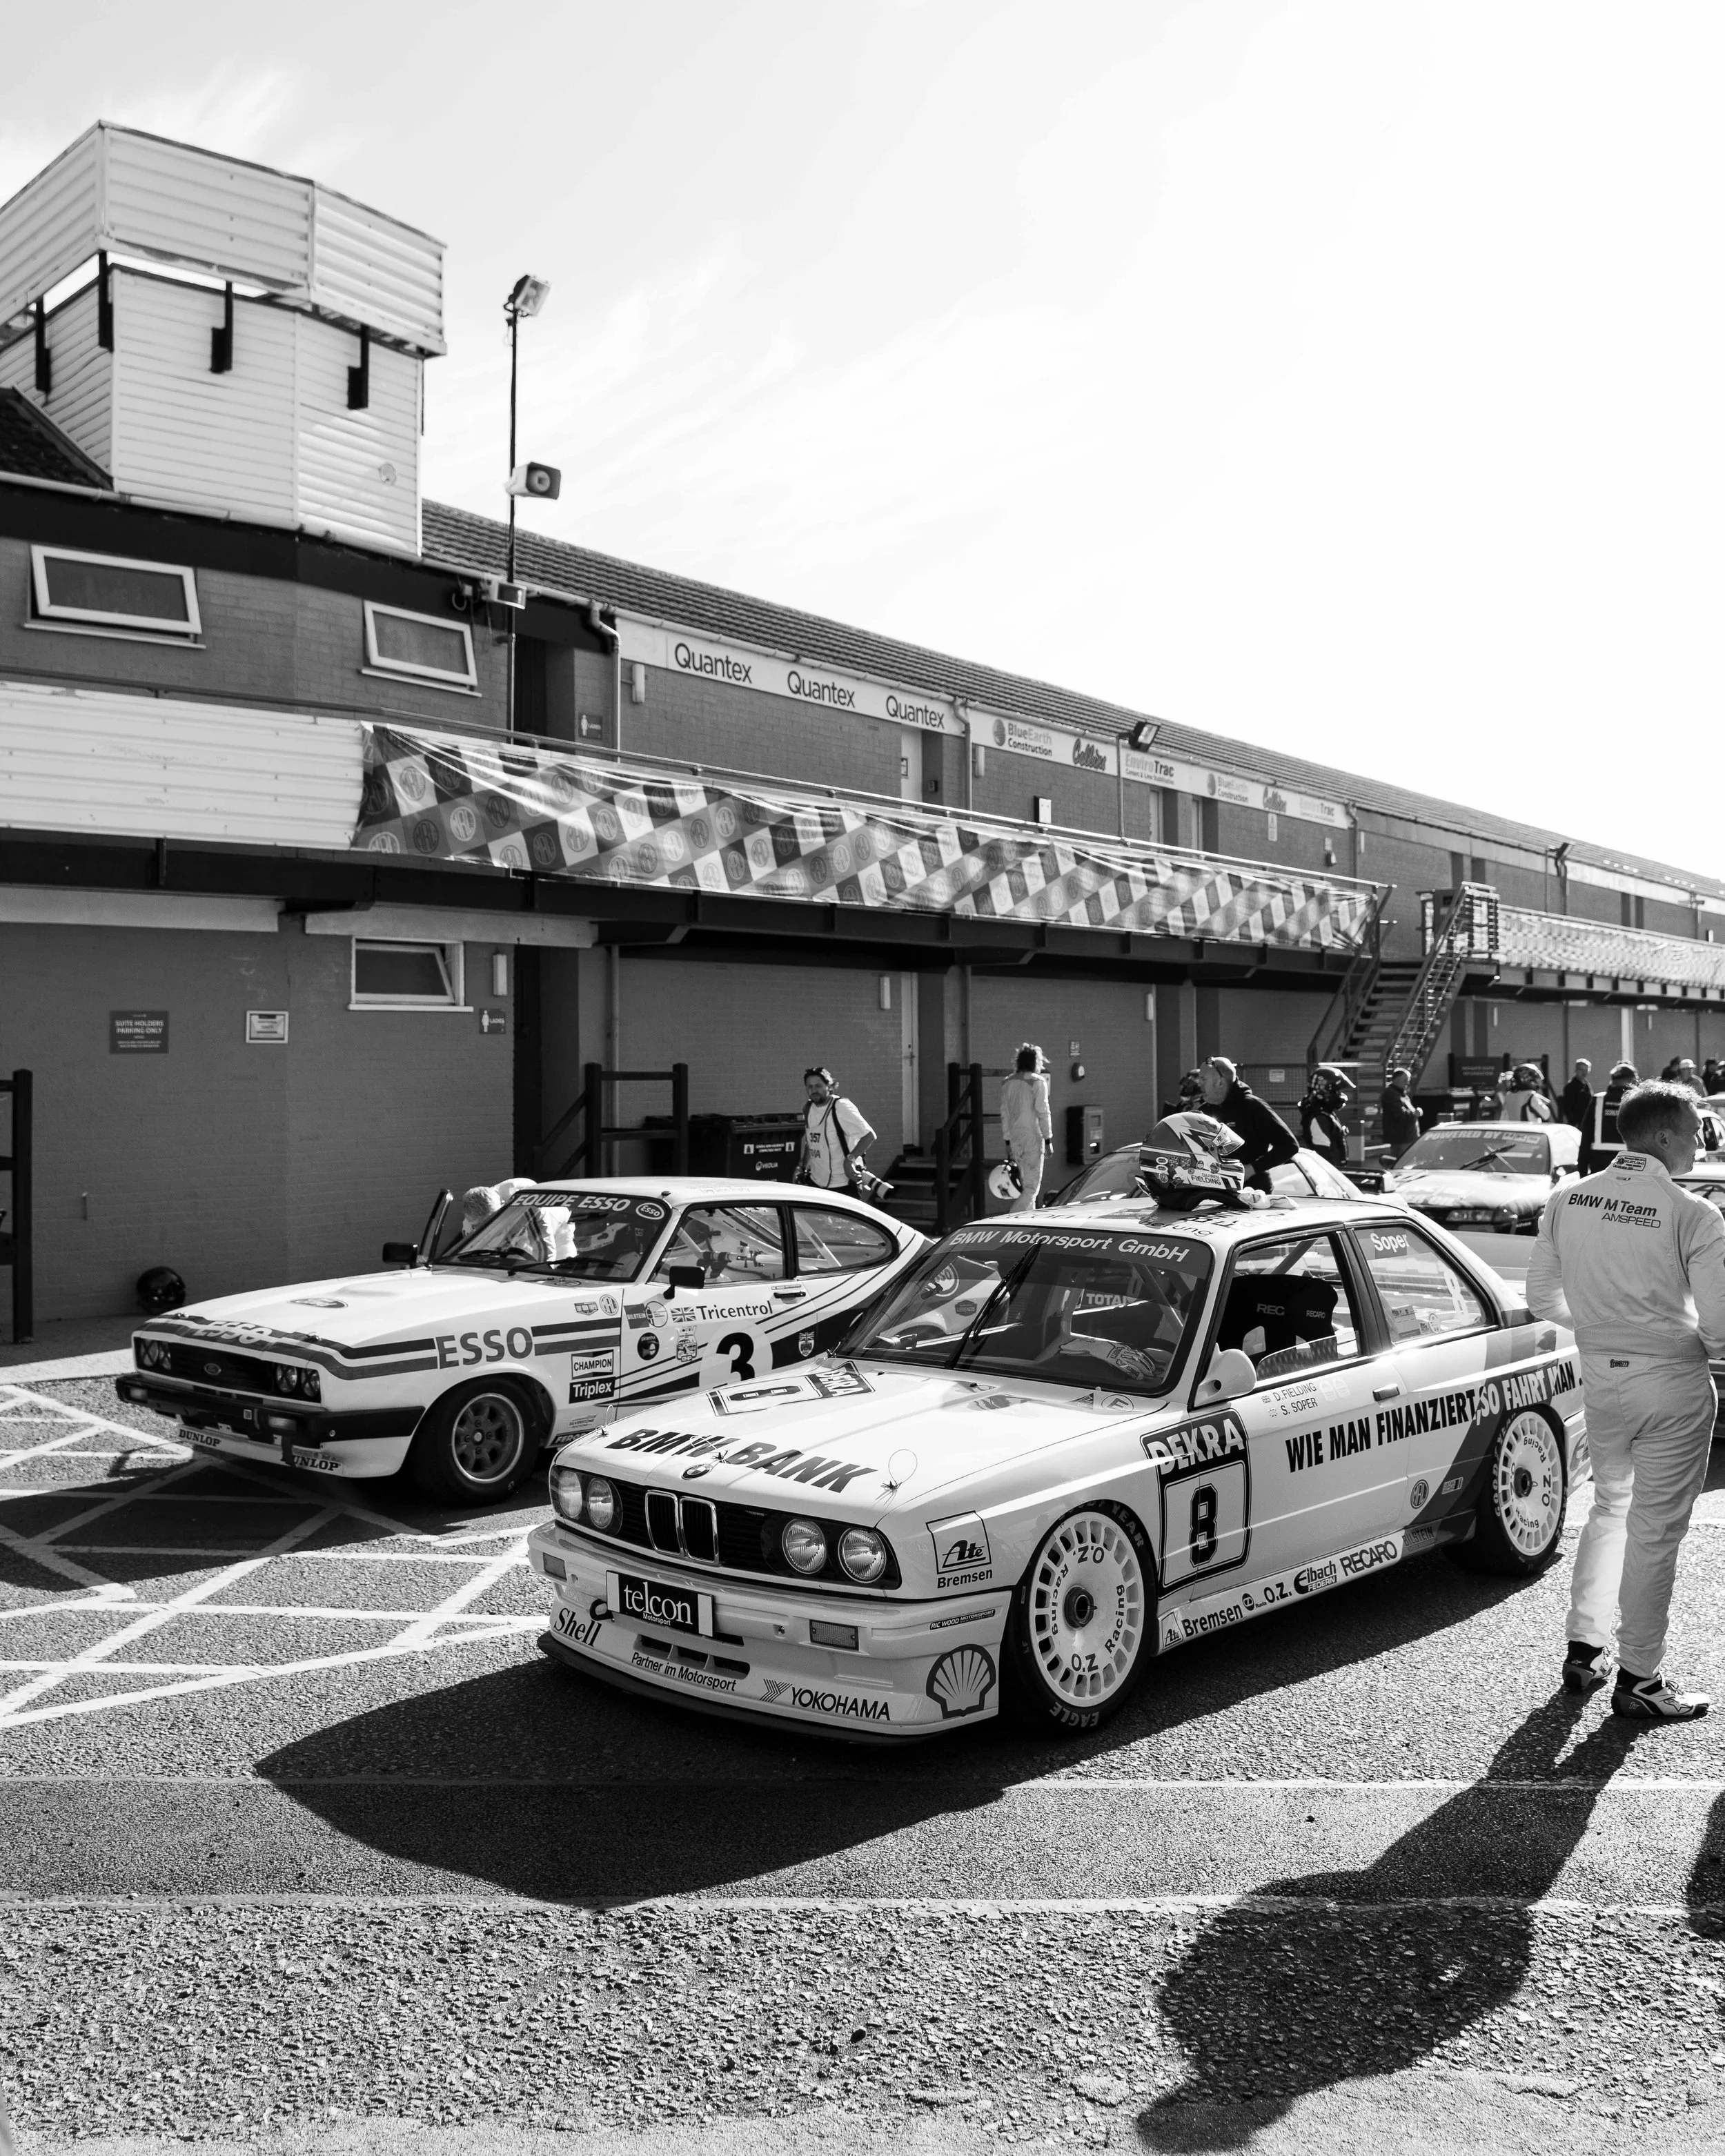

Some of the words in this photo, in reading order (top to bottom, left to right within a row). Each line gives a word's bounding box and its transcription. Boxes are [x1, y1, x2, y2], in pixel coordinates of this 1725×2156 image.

[675, 642, 752, 684] Quantex
[787, 671, 856, 708] Quantex
[886, 695, 945, 729] Quantex
[1008, 724, 1052, 745] BlueEarth
[1008, 738, 1052, 757] Construction
[1423, 1130, 1482, 1141] POWERED
[1484, 1131, 1502, 1139] BY
[1191, 1175, 1221, 1185] FIELDING
[511, 1194, 579, 1207] EQUIPE
[578, 1196, 631, 1211] ESSO
[1568, 1194, 1604, 1208] BMW
[1604, 1198, 1619, 1211] M
[1620, 1200, 1657, 1217] Team
[1601, 1212, 1661, 1229] AMSPEED
[949, 1230, 1001, 1246] BMW
[1000, 1231, 1113, 1249] Motorsport
[1118, 1238, 1191, 1263] GmbH
[1370, 1232, 1410, 1253] Soper
[696, 1300, 773, 1320] Tricentrol
[1306, 1310, 1325, 1318] RECARO
[193, 1321, 273, 1344] ESSO
[435, 1327, 533, 1369] ESSO
[716, 1332, 756, 1381] 3
[574, 1358, 612, 1372] CHAMPION
[573, 1381, 613, 1398] Triplex
[1281, 1405, 1291, 1416] S.
[1291, 1398, 1318, 1413] SOPER
[1285, 1430, 1323, 1474] WIE
[1330, 1416, 1371, 1461] MAN
[1480, 1385, 1501, 1418] SO
[1504, 1370, 1546, 1410] FAHRT
[1546, 1361, 1576, 1396] MAN
[179, 1428, 221, 1447] DUNLOP
[1147, 1418, 1245, 1476] DEKRA
[604, 1428, 740, 1458] BMW
[724, 1442, 878, 1494] BANK
[1523, 1436, 1547, 1463] Racing
[283, 1455, 341, 1472] UNLOP
[1189, 1483, 1219, 1568] 8
[1402, 1526, 1435, 1547] BILSTEIN
[942, 1540, 987, 1568] Ate
[1340, 1540, 1398, 1577] RECARO
[937, 1570, 994, 1589] Bremsen
[1293, 1560, 1337, 1595] Eibach
[1308, 1575, 1337, 1592] FEDERN
[624, 1581, 693, 1625] telcon
[1051, 1563, 1070, 1636] Racing
[1263, 1582, 1292, 1604] O.Z.
[553, 1608, 602, 1648] Shell
[642, 1612, 671, 1626] Motorsport
[941, 1618, 960, 1627] WOOD
[960, 1610, 994, 1621] MOTORSPORT
[1105, 1584, 1125, 1654] Racing
[1181, 1603, 1243, 1638] Bremsen
[1164, 1628, 1182, 1648] Ate
[631, 1652, 663, 1673] Partner
[664, 1662, 677, 1677] im
[678, 1666, 737, 1692] Motorsport
[791, 1687, 891, 1721] YOKOHAMA
[1049, 1701, 1100, 1728] EAGLE
